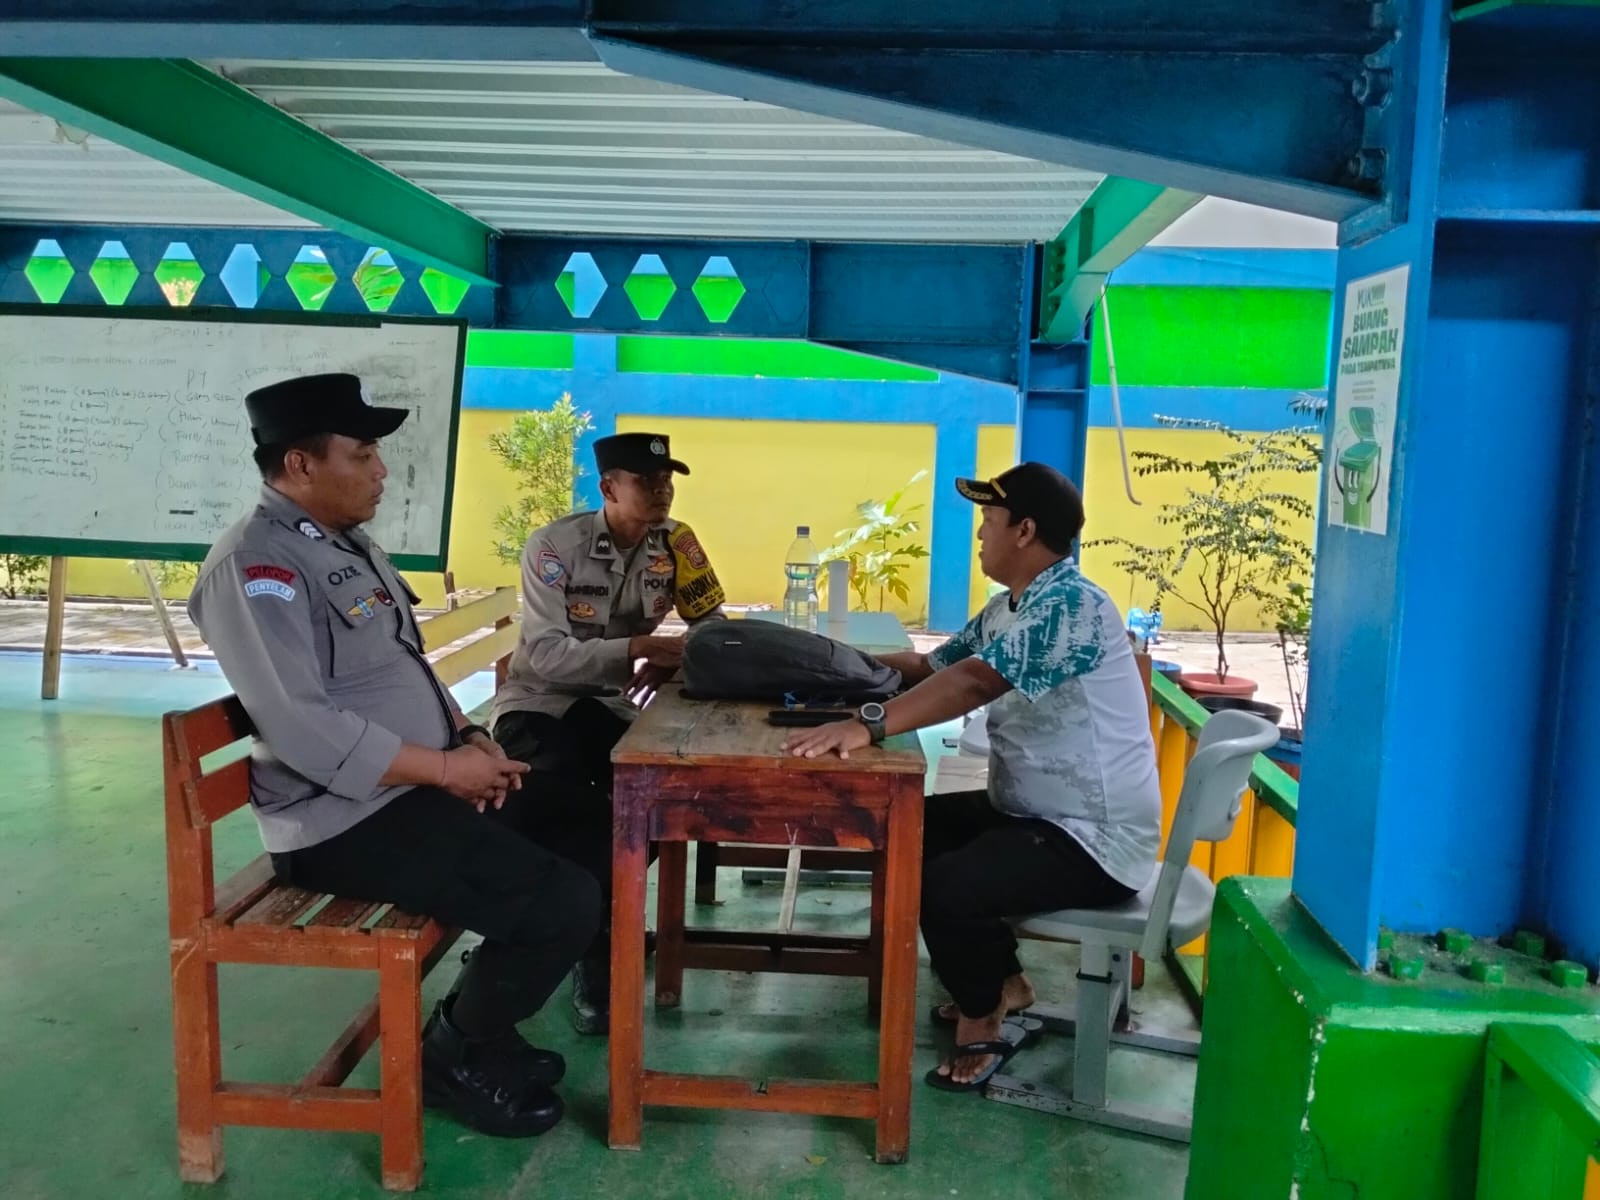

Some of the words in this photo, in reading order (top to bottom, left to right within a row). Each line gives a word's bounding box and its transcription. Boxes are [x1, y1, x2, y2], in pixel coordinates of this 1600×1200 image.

[1353, 307, 1389, 333] BUANG
[1343, 328, 1399, 360] SAMPAH
[1340, 362, 1356, 376] PADA
[1357, 358, 1396, 374] TEMPATNYA
[250, 581, 291, 597] PENYELAM
